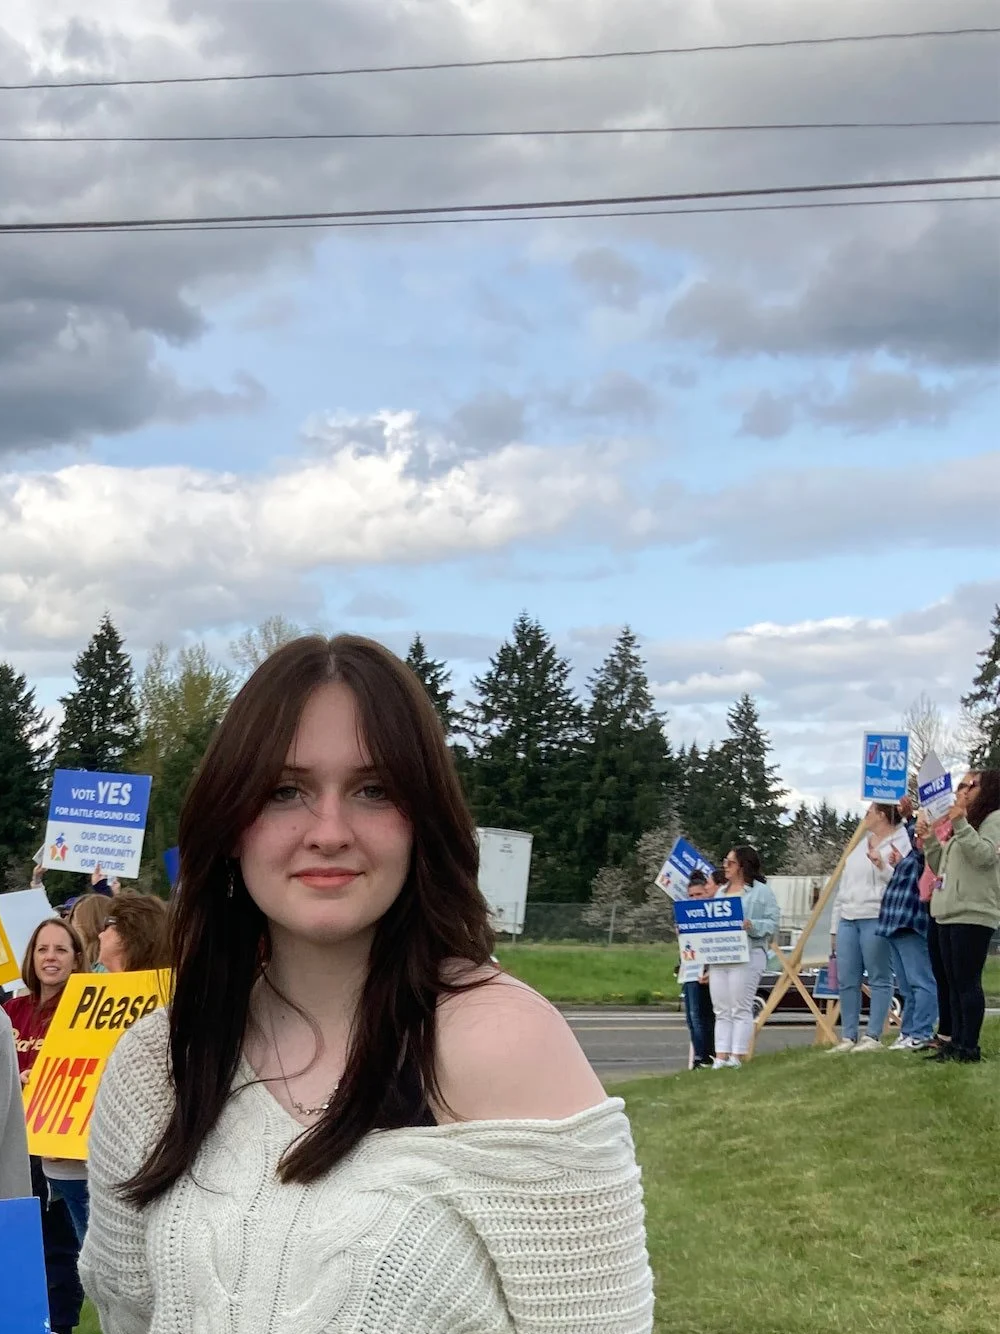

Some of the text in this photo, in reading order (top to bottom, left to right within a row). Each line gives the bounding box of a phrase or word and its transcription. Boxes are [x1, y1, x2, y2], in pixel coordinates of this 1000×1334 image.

[880, 750, 906, 771] YES
[71, 781, 133, 805] VOTE YES
[55, 807, 140, 822] FOR BATTLE GROUND KIDS
[81, 831, 132, 845] OUR SCHOOLS
[73, 844, 136, 858] OUR COMMUNITY
[80, 859, 97, 868] OUR
[685, 900, 732, 918] VOTE YES
[68, 985, 158, 1031] Please
[25, 1056, 100, 1135] VOTE
